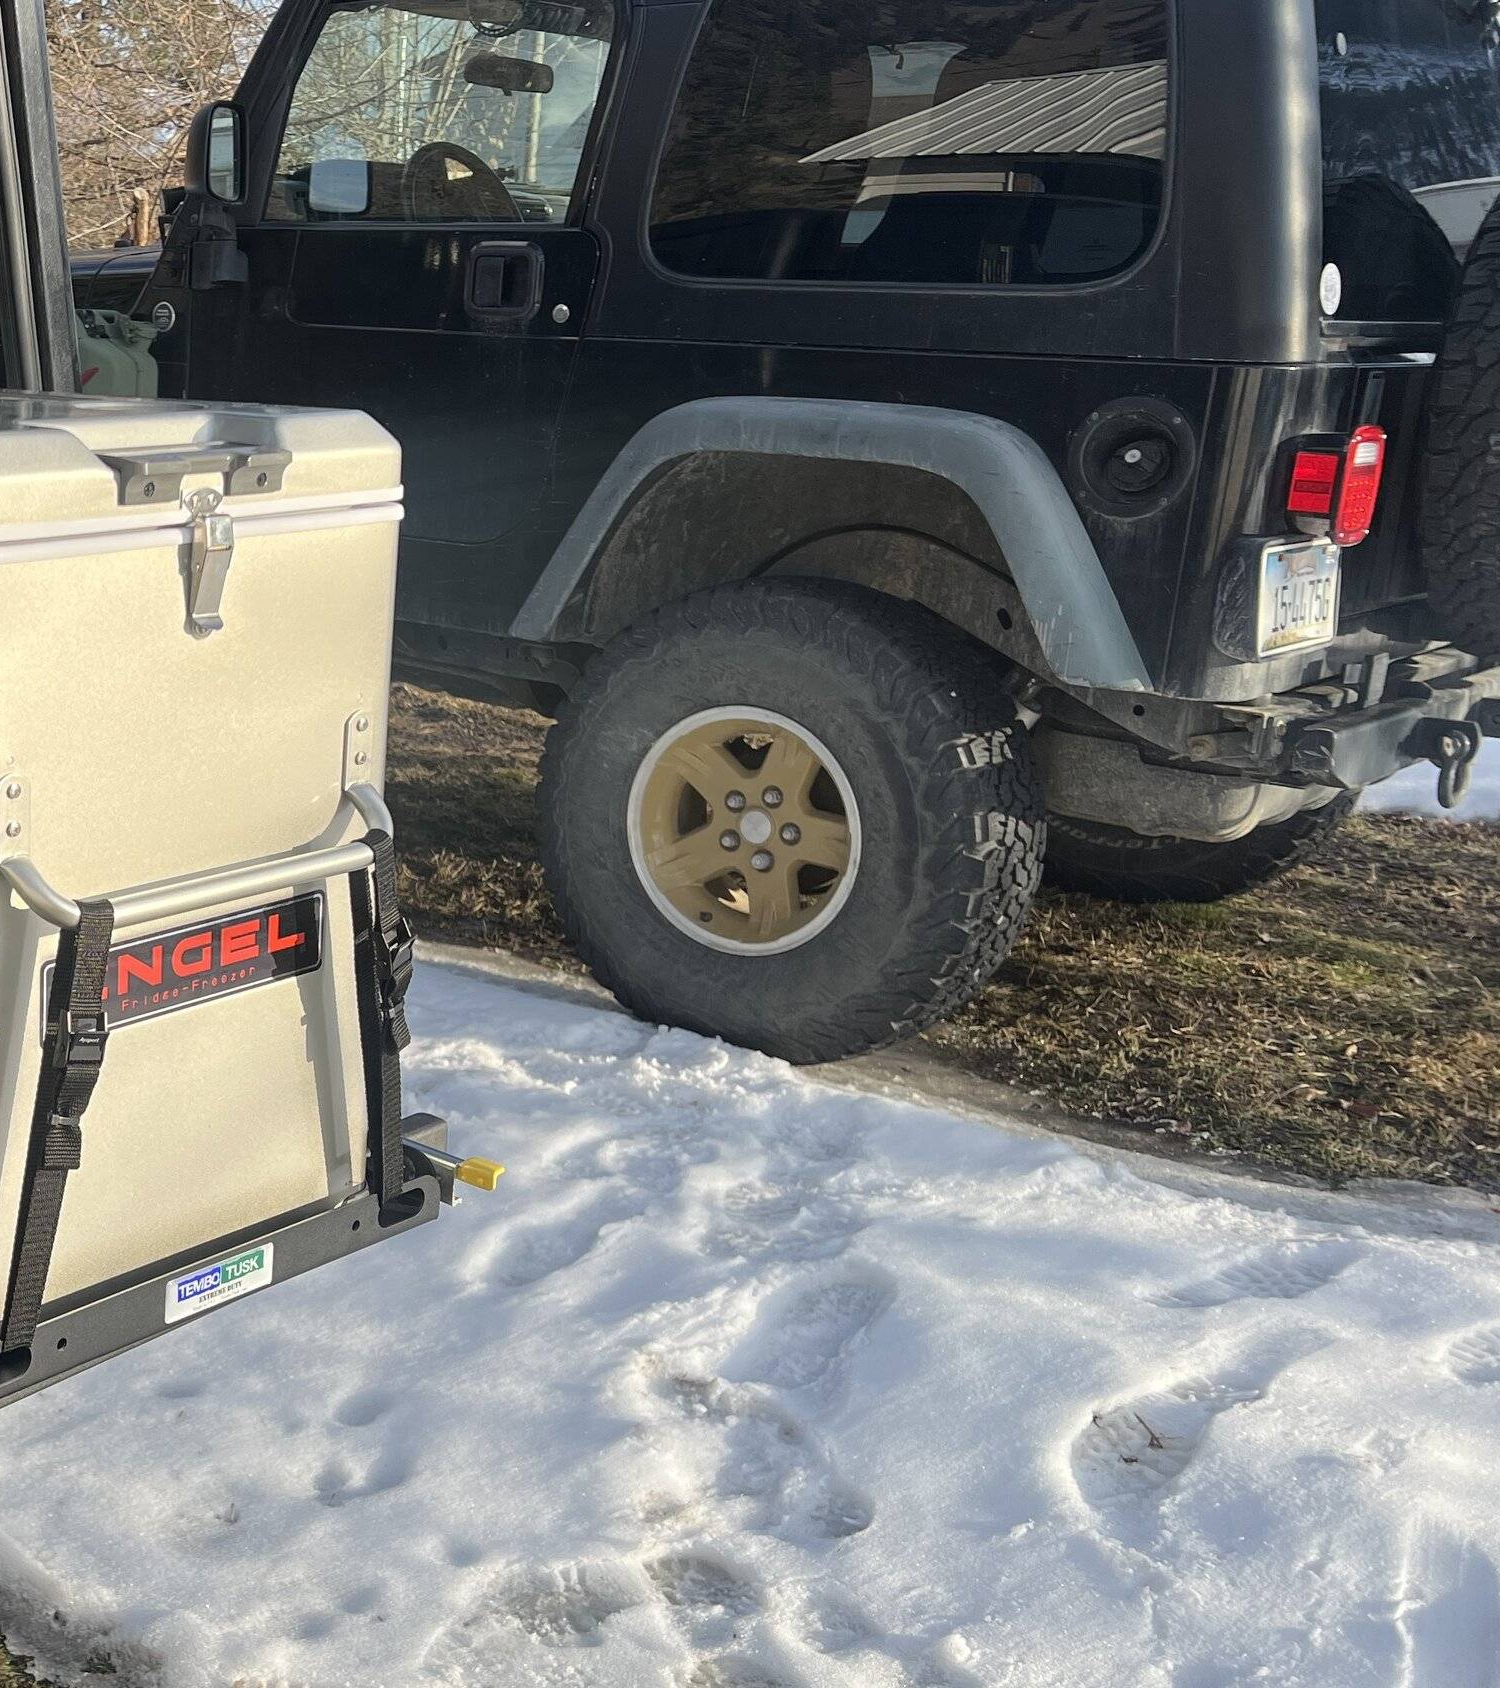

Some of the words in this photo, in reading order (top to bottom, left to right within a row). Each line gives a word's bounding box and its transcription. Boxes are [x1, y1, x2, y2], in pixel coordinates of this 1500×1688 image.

[102, 913, 305, 1000] NGEL
[120, 966, 256, 1012] Fridge-Freezer
[178, 1272, 220, 1299] TEMBO
[226, 1256, 259, 1280] TUSK
